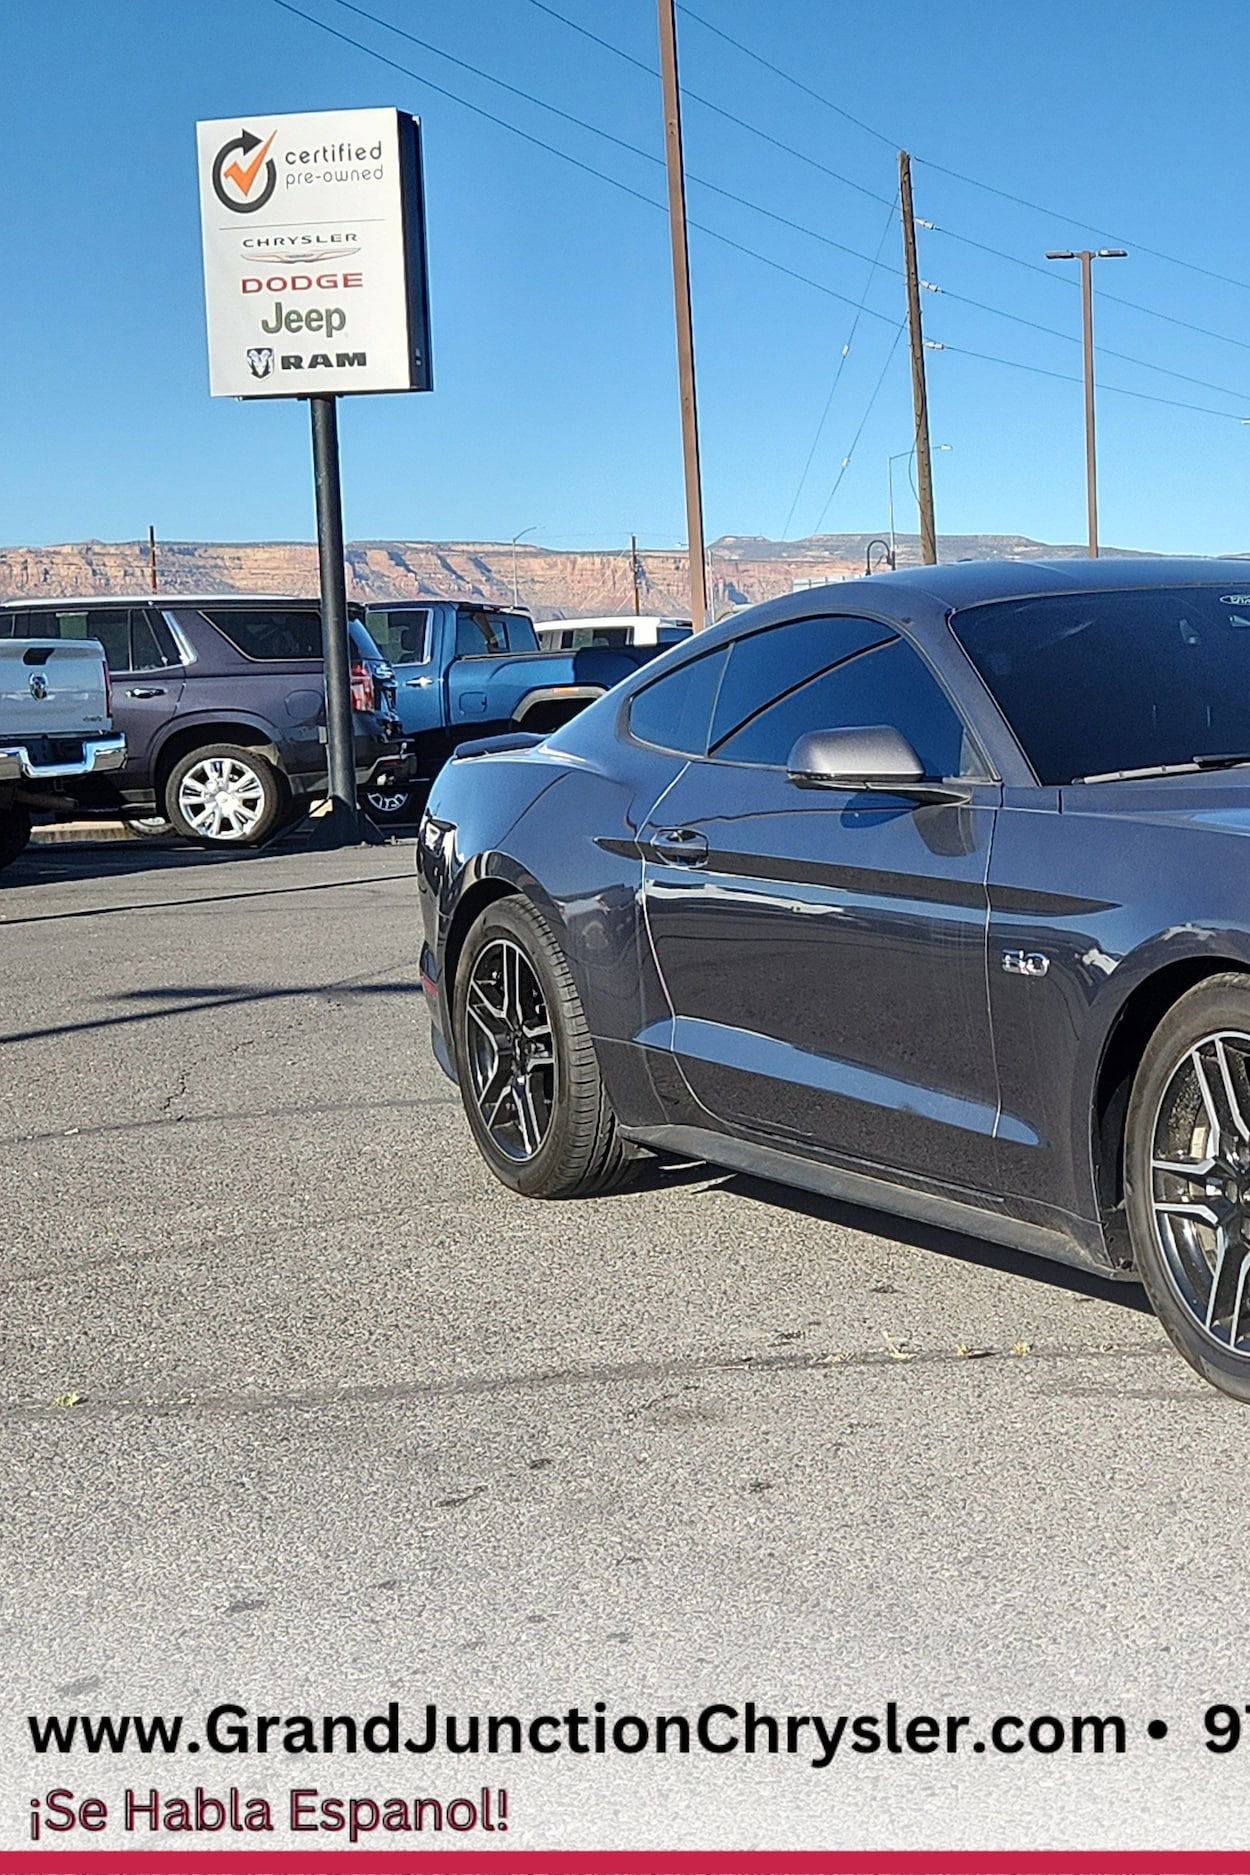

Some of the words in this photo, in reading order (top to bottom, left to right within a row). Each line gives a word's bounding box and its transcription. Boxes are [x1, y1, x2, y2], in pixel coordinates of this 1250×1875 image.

[285, 140, 382, 166] certified
[286, 165, 384, 190] pre-owned
[242, 232, 359, 248] CHRYSLER
[241, 272, 364, 294] DODGE
[261, 301, 347, 338] Jeep
[280, 351, 368, 371] RAM
